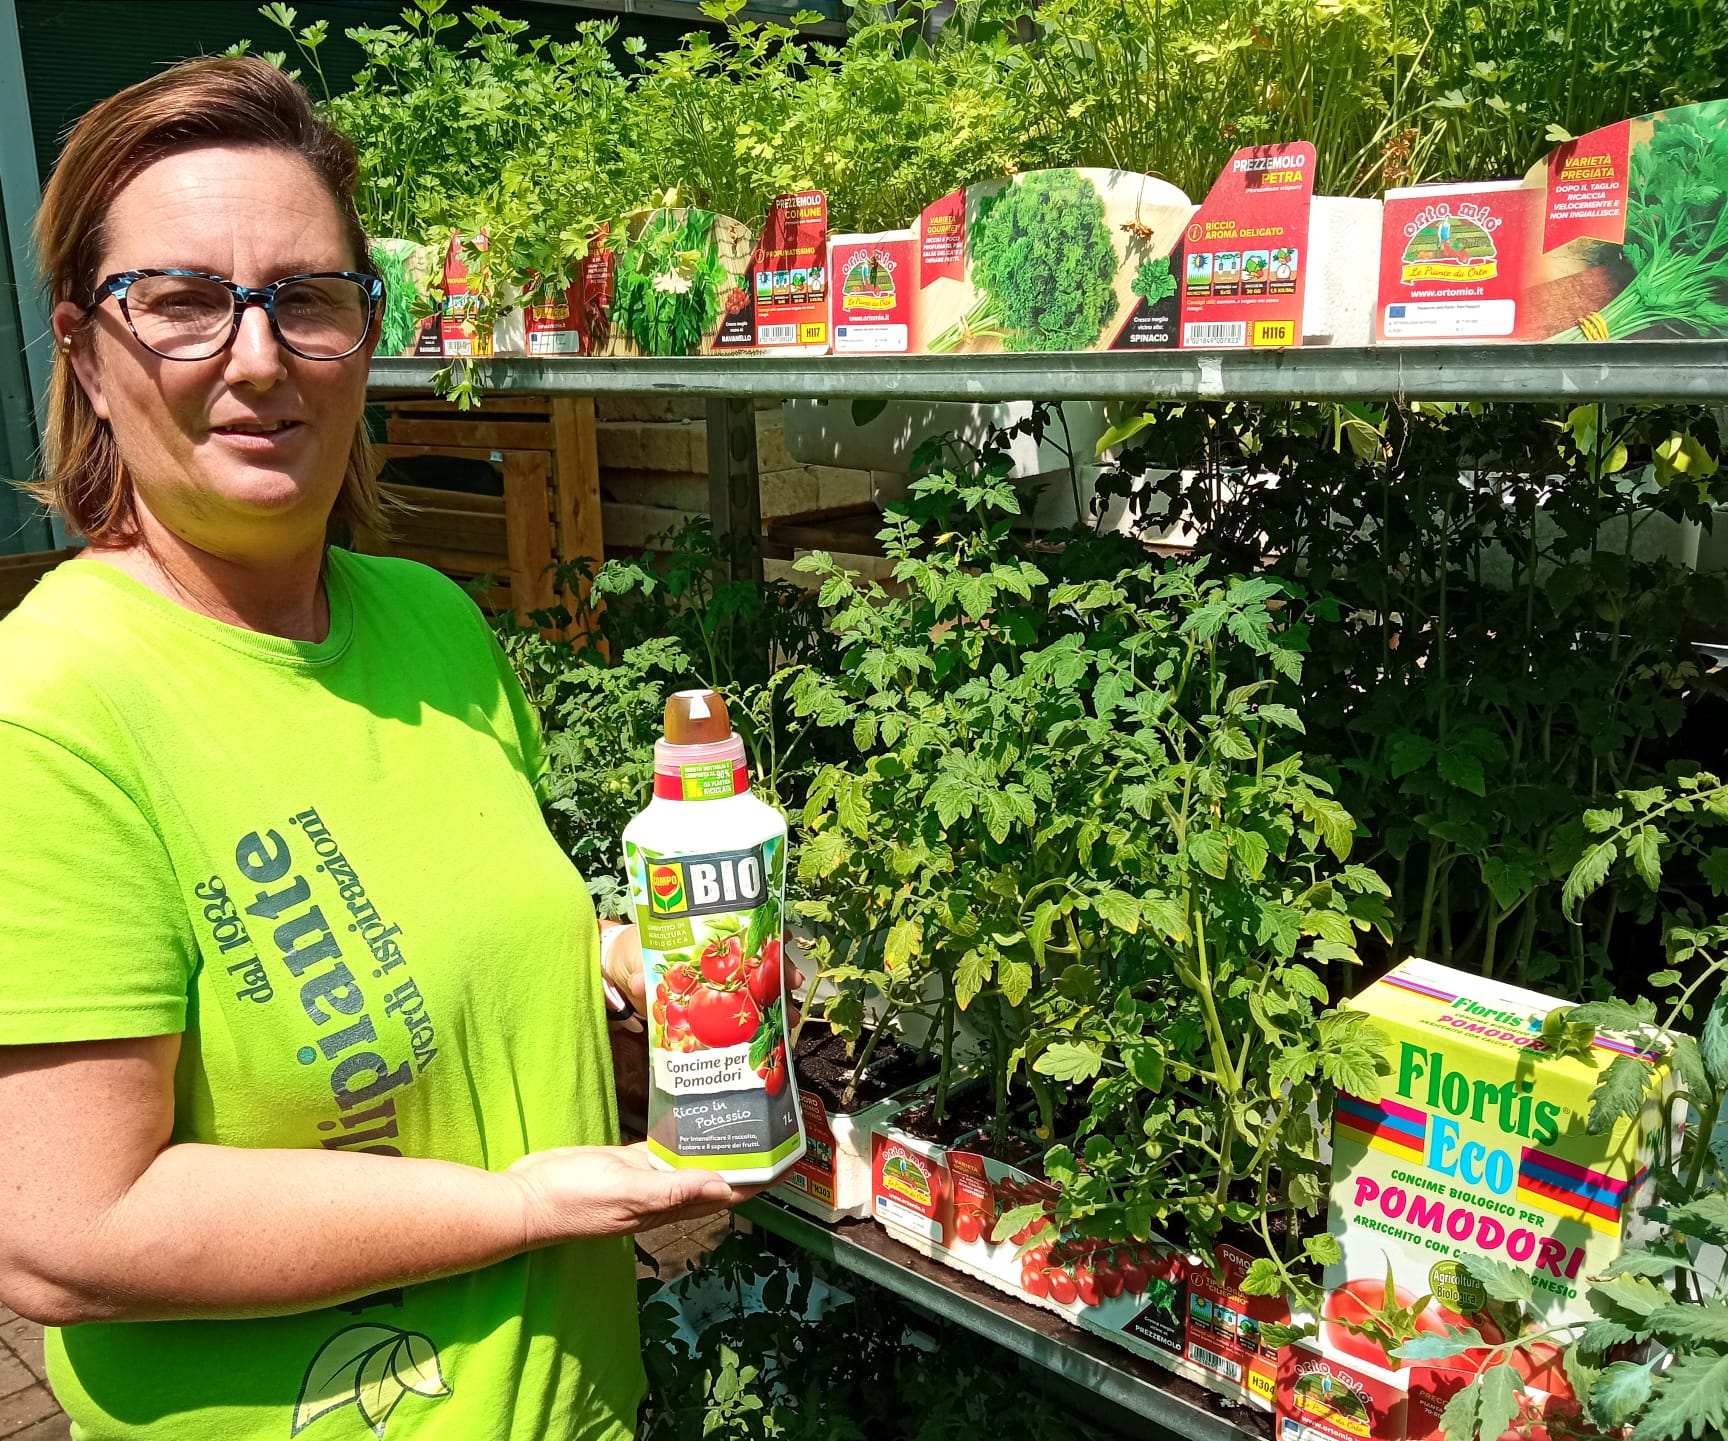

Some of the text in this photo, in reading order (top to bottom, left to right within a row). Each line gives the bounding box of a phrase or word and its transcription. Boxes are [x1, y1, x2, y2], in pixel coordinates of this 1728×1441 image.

[1233, 155, 1304, 172] PREZZEMOLO
[1566, 154, 1611, 167] VARIETÀ
[1262, 171, 1302, 184] PETRA
[1561, 168, 1614, 179] PREGIATA
[1590, 182, 1619, 190] TAGLIO
[776, 195, 821, 209] PREZZEMOLO
[1567, 192, 1605, 200] RICACCIA
[1554, 201, 1611, 210] VELOCEMENTE
[784, 208, 822, 219] COMUNE
[1205, 221, 1235, 231] RICCIO
[1205, 227, 1283, 239] AROMA DELICATO
[765, 247, 815, 258] PROFUMATISSIMO
[1410, 268, 1421, 276] Le
[1411, 287, 1483, 297] www.ortomio.it
[806, 327, 820, 337] H117
[1130, 333, 1168, 342] SPINACIO
[1262, 327, 1285, 339] H116
[653, 875, 677, 886] COMPO
[690, 856, 760, 905] BIO
[195, 875, 273, 1004] dal 1936
[289, 806, 438, 1073] verdi ispirazioni
[1451, 997, 1524, 1027] Flortis
[1437, 1015, 1553, 1051] POMODORI
[667, 1053, 748, 1072] Concime per
[674, 1069, 741, 1088] Pomodori
[1396, 1041, 1560, 1147] Flortis
[673, 1101, 727, 1120] Ricco in
[695, 1110, 751, 1129] Potassio
[782, 1112, 793, 1126] 1L
[711, 1142, 731, 1151] sapore
[732, 1141, 741, 1149] dei
[742, 1140, 760, 1148] frutti.
[1427, 1114, 1514, 1195] Eco
[814, 1185, 831, 1198] H303
[1392, 1170, 1544, 1228] CONCIME BIOLOGICO PER
[1354, 1176, 1586, 1280] POMODORI
[1354, 1215, 1421, 1245] ARRICCHITO
[1425, 1239, 1448, 1255] CON
[1223, 1250, 1250, 1269] POMO
[1434, 1270, 1480, 1289] Agricoltura
[1514, 1270, 1577, 1299] GNESIO
[1438, 1286, 1475, 1304] Biologica
[1135, 1324, 1182, 1350] PREZZEMOLO
[1253, 1376, 1275, 1394] H304
[1419, 1400, 1443, 1413] PIANTA
